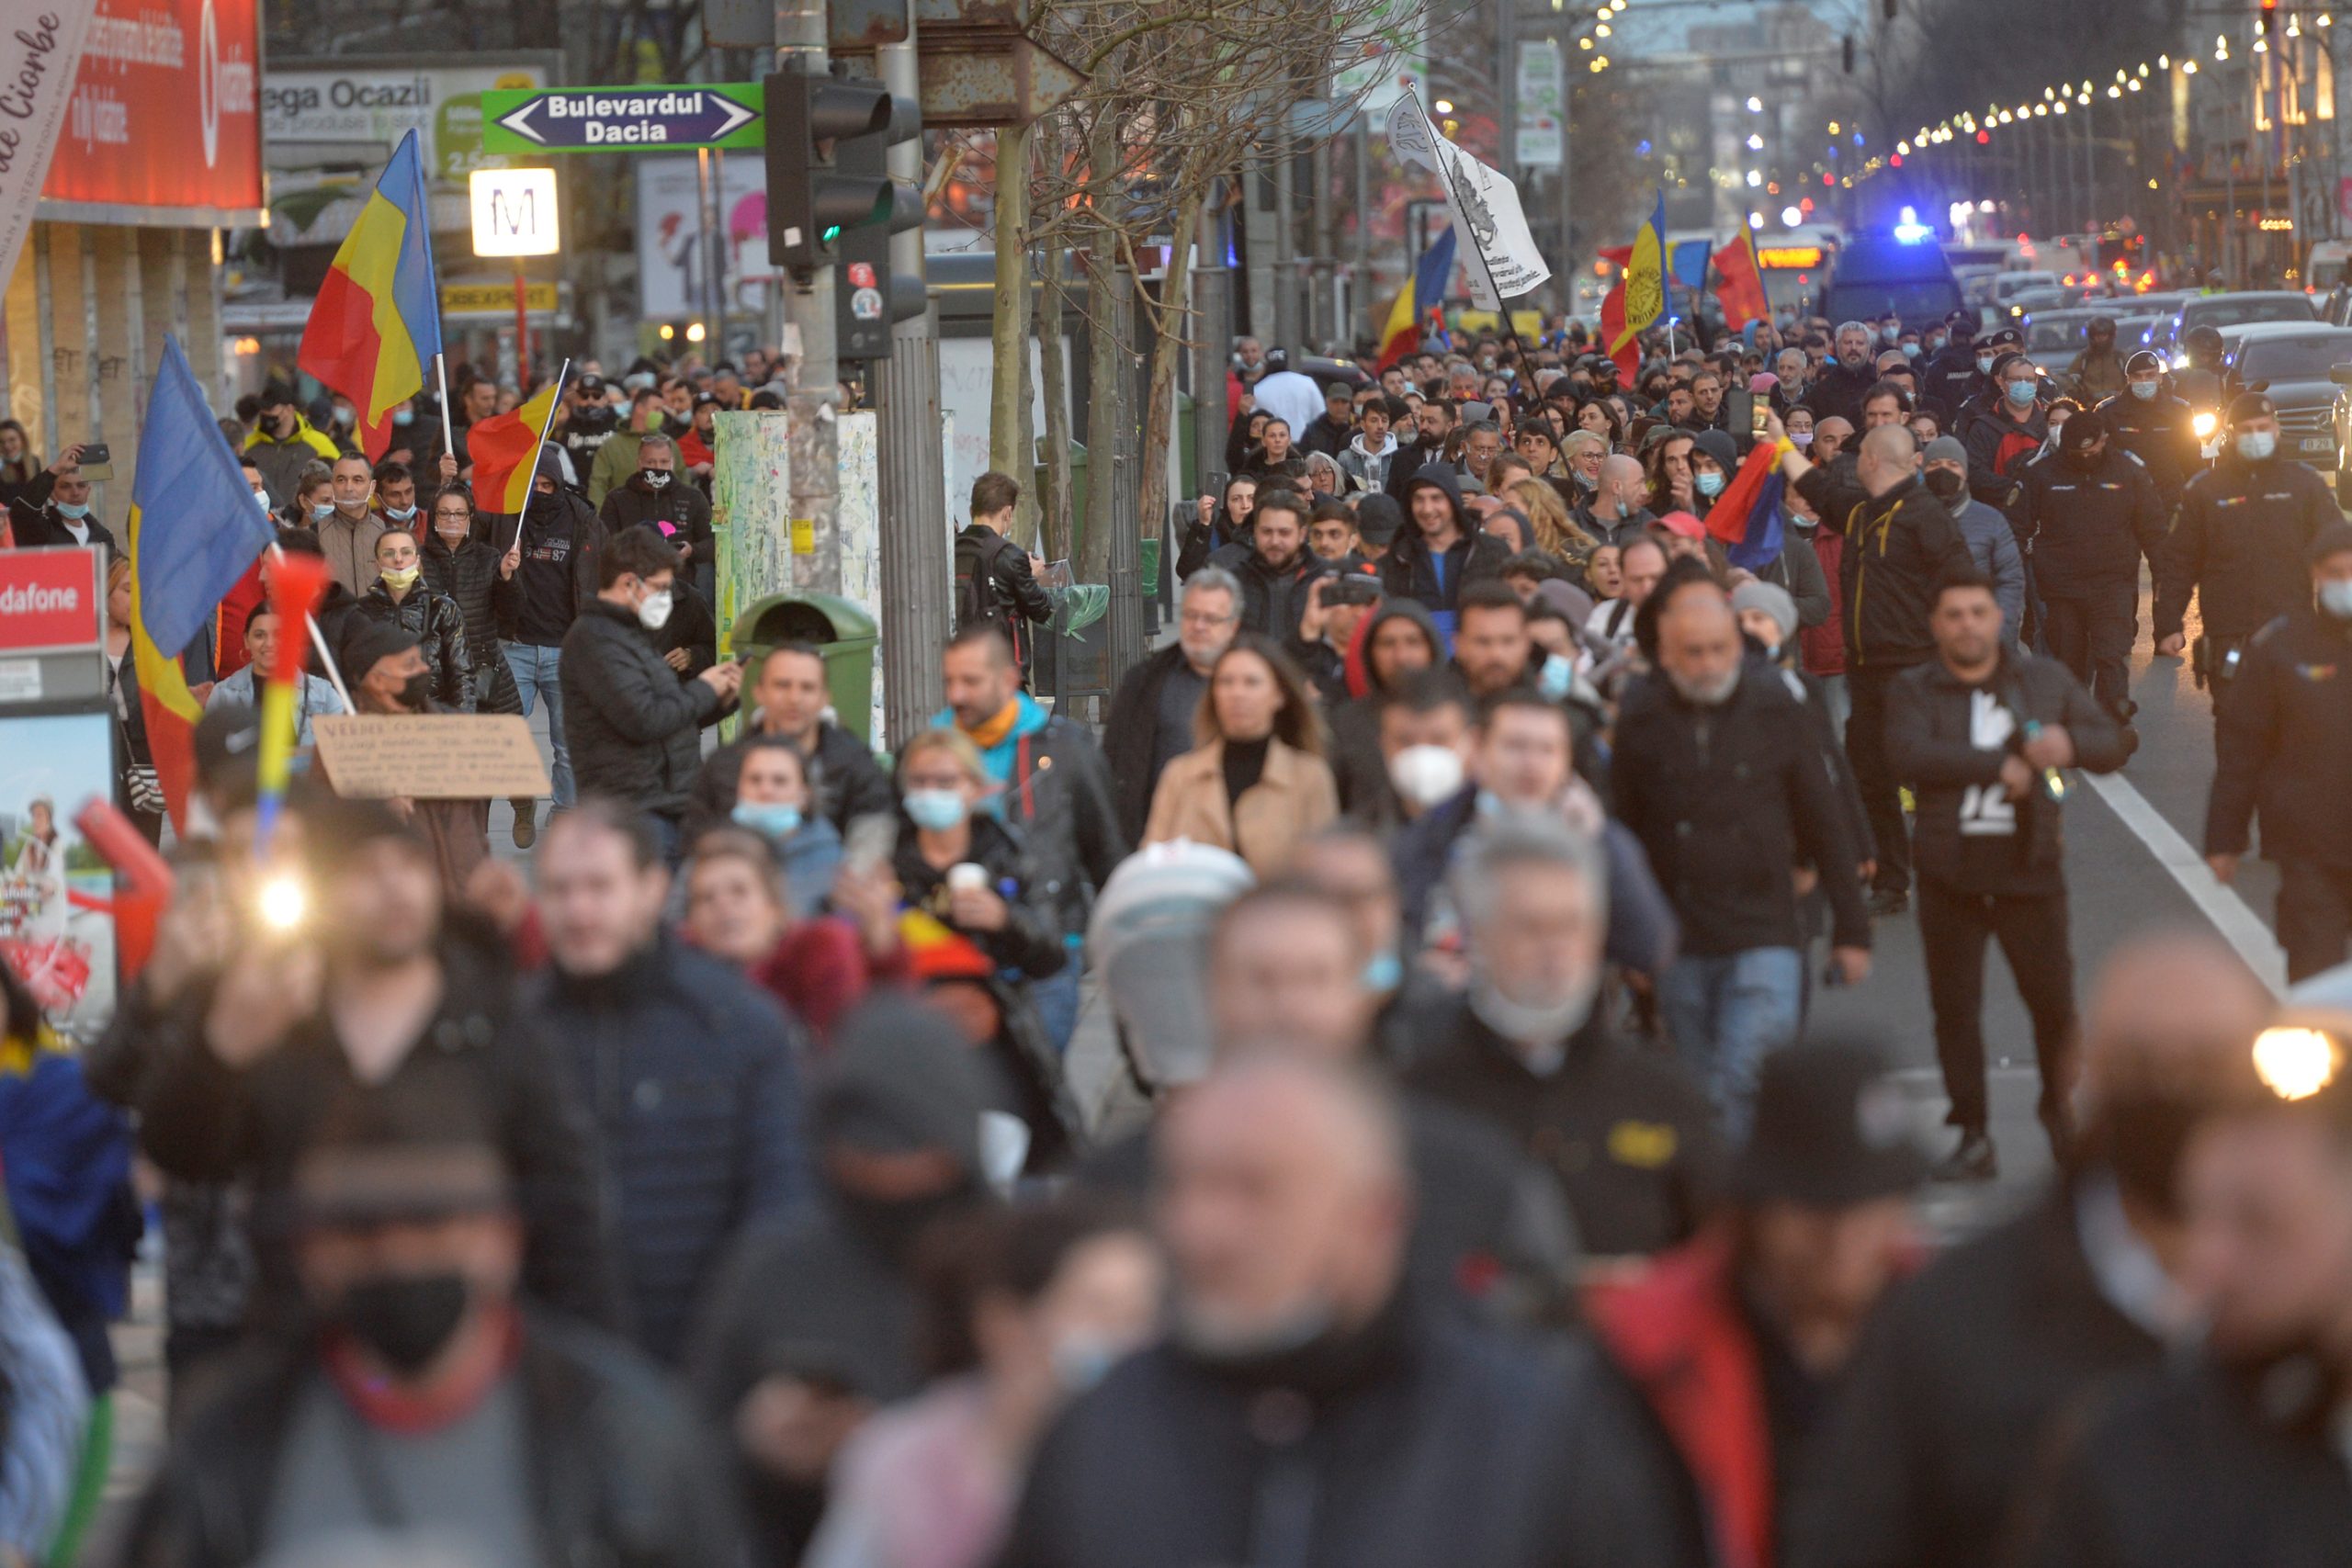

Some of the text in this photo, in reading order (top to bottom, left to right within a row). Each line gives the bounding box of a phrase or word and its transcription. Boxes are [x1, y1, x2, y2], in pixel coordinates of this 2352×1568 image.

[0, 11, 60, 119] Ciorbe
[329, 76, 432, 108] Ocazii
[548, 92, 703, 118] Bulevardul
[585, 119, 667, 143] Dacia
[17, 104, 60, 209] INTERNATIONAL
[492, 188, 536, 236] M
[551, 548, 567, 562] 87
[0, 582, 78, 614] dafone
